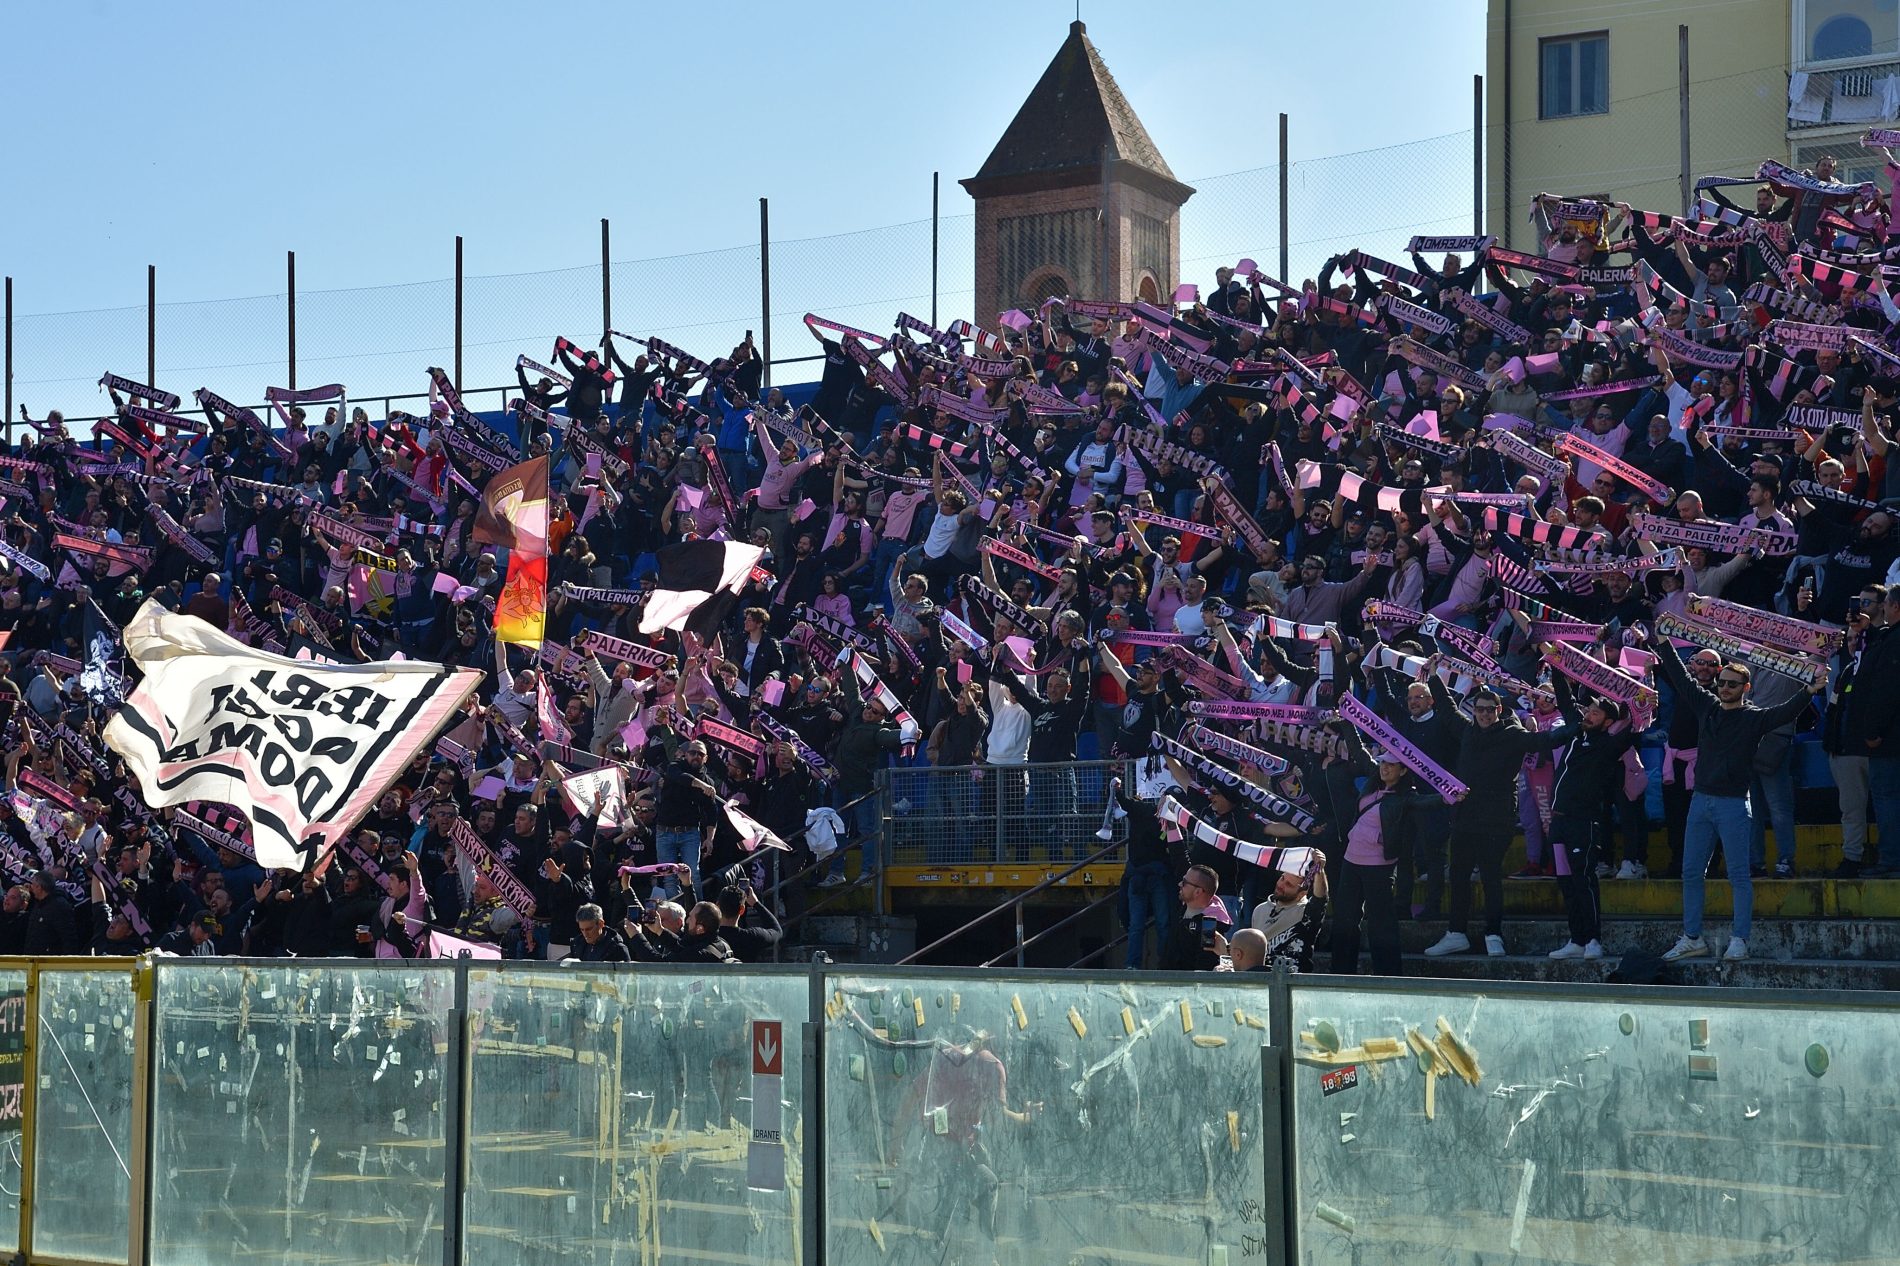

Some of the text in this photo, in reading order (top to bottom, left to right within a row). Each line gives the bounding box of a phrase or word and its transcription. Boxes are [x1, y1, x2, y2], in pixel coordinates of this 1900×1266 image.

[1774, 329, 1818, 341] FORZA
[523, 358, 573, 388] PALERMO
[112, 376, 165, 406] PALERMO
[1027, 388, 1054, 406] FORZA
[767, 413, 803, 442] PALERMO
[451, 433, 504, 468] PALERMO
[569, 427, 621, 468] PALERMO
[1129, 428, 1210, 474] PALERMO
[1497, 434, 1565, 474] FORZA PALERMO
[1569, 439, 1597, 457] FORZA
[310, 513, 375, 549] PALERMO
[1137, 510, 1218, 535] PALERMO
[1642, 522, 1739, 544] FORZA PALERMO
[996, 543, 1027, 564] FORZA
[587, 589, 641, 605] PALERMO
[967, 575, 1041, 634] ANGELI
[1705, 604, 1812, 645] FORZA PALERMO
[586, 631, 669, 666] PALERMO
[1440, 628, 1521, 684] PALERMO
[1660, 618, 1818, 680] CATANIA MERDA
[1560, 647, 1640, 699] FORZA PALERMO
[1230, 706, 1270, 716] ROSANERO
[1271, 709, 1285, 718] NEL
[1287, 709, 1316, 720] MONDO
[1203, 732, 1276, 770] PALERMO
[1239, 781, 1291, 817] SOLO
[753, 1129, 780, 1140] IDRANTE
